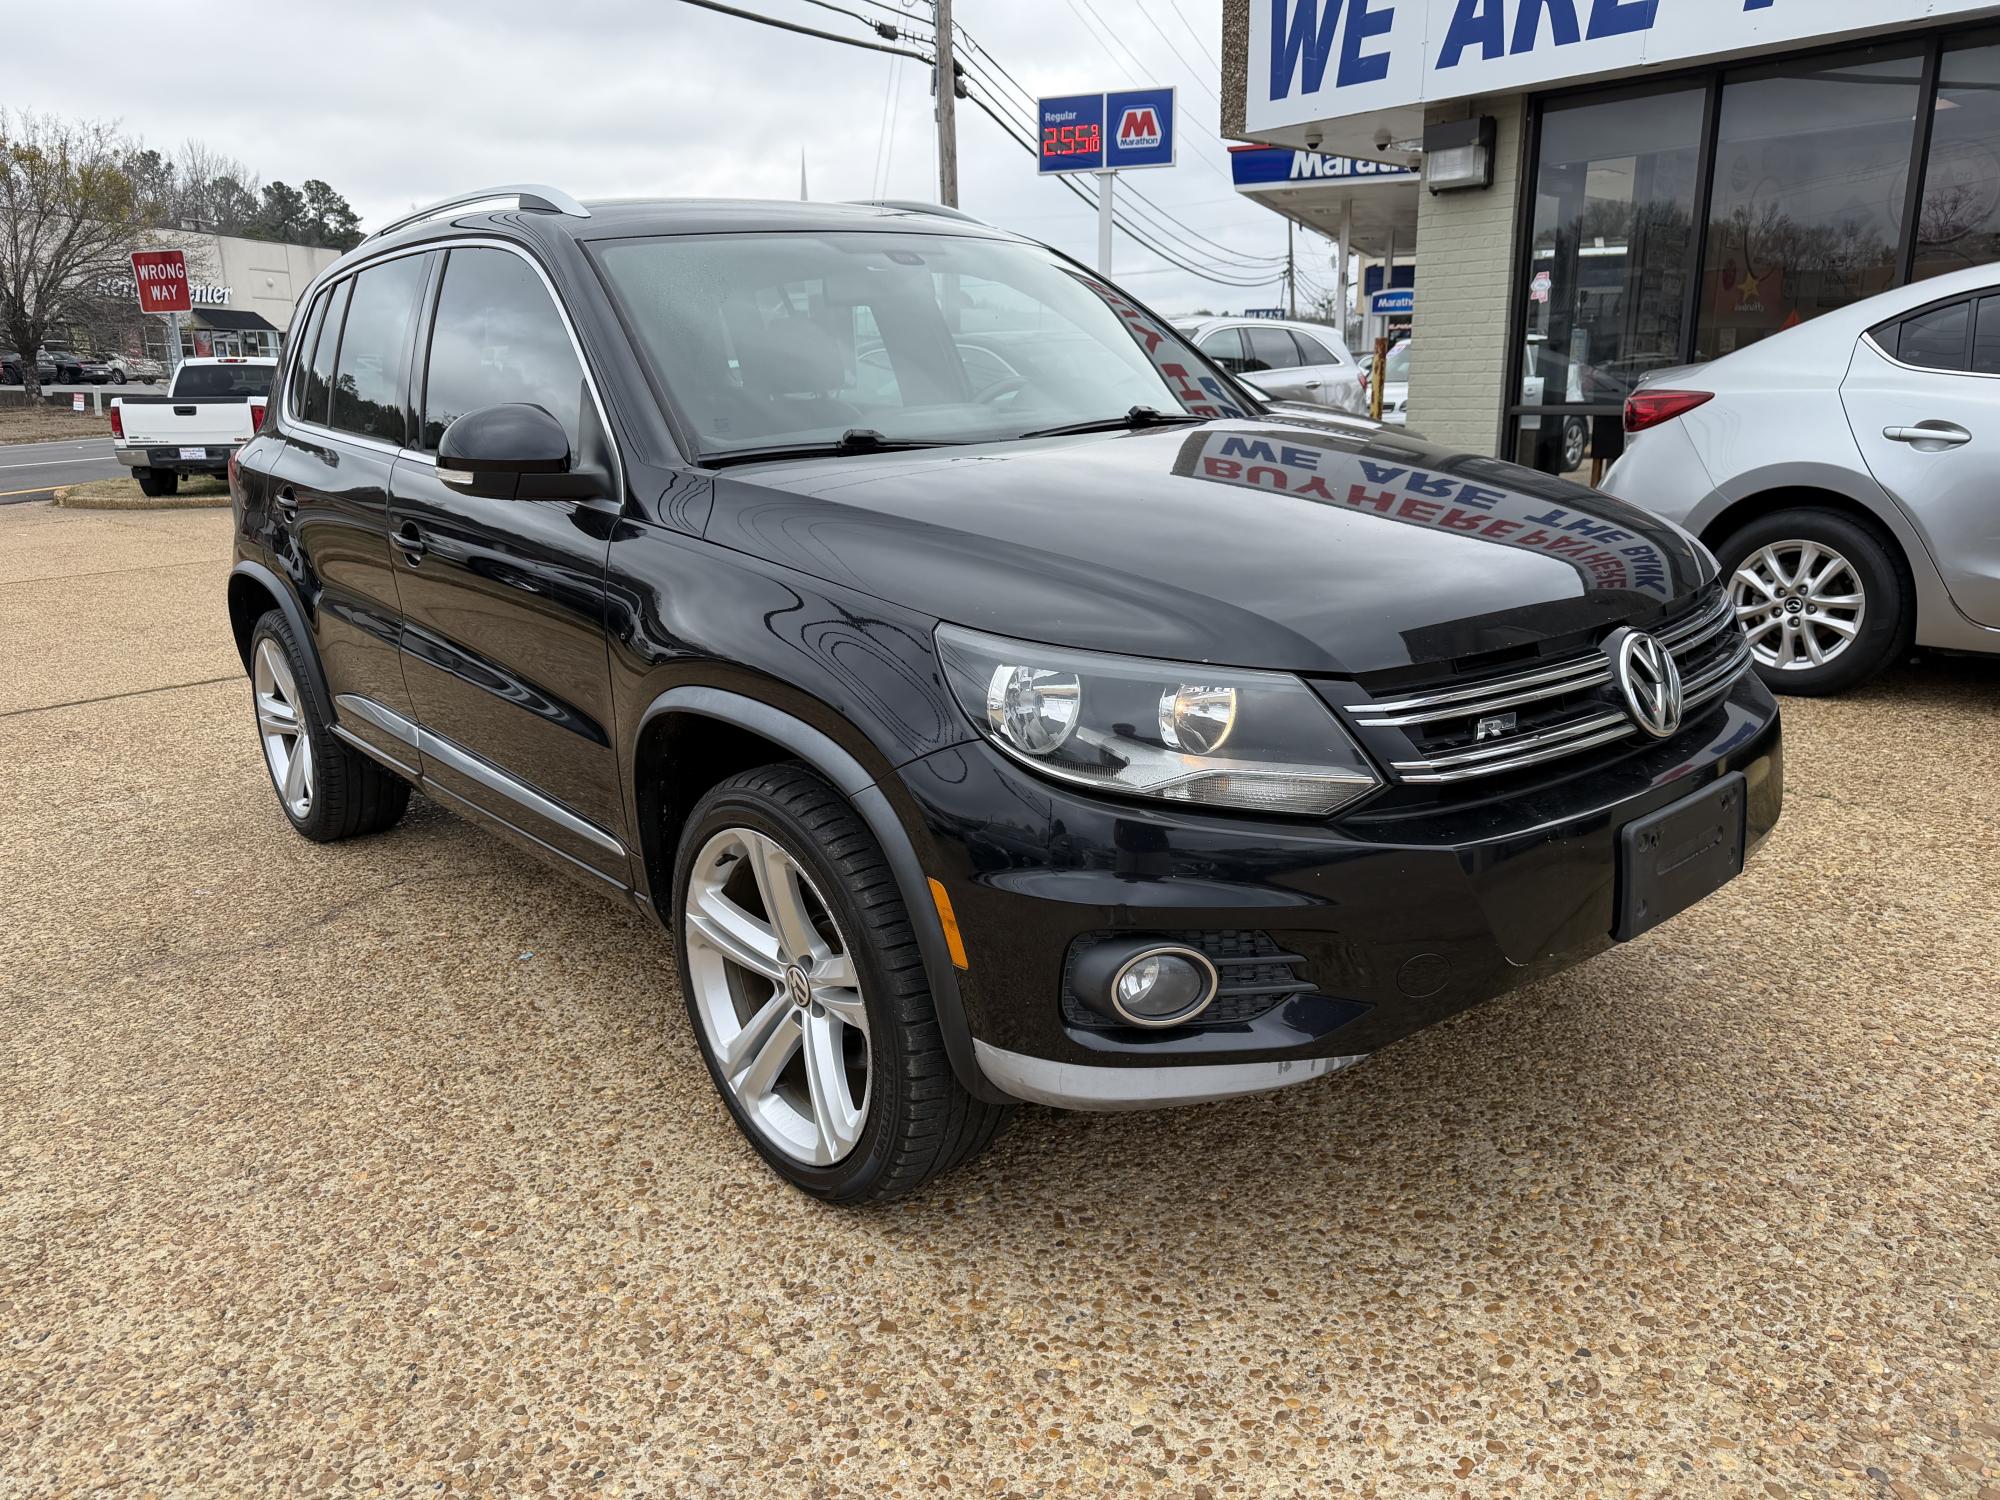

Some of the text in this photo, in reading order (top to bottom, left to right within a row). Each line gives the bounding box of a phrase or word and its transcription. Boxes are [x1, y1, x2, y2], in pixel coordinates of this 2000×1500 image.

[1269, 0, 1396, 101] WE
[1044, 111, 1077, 123] Regular
[1043, 124, 1090, 156] 2.55
[1119, 137, 1158, 147] Marathon
[1289, 150, 1411, 179] Mara
[138, 263, 184, 281] WRONG
[150, 284, 178, 301] WAY
[1377, 296, 1413, 308] Marath
